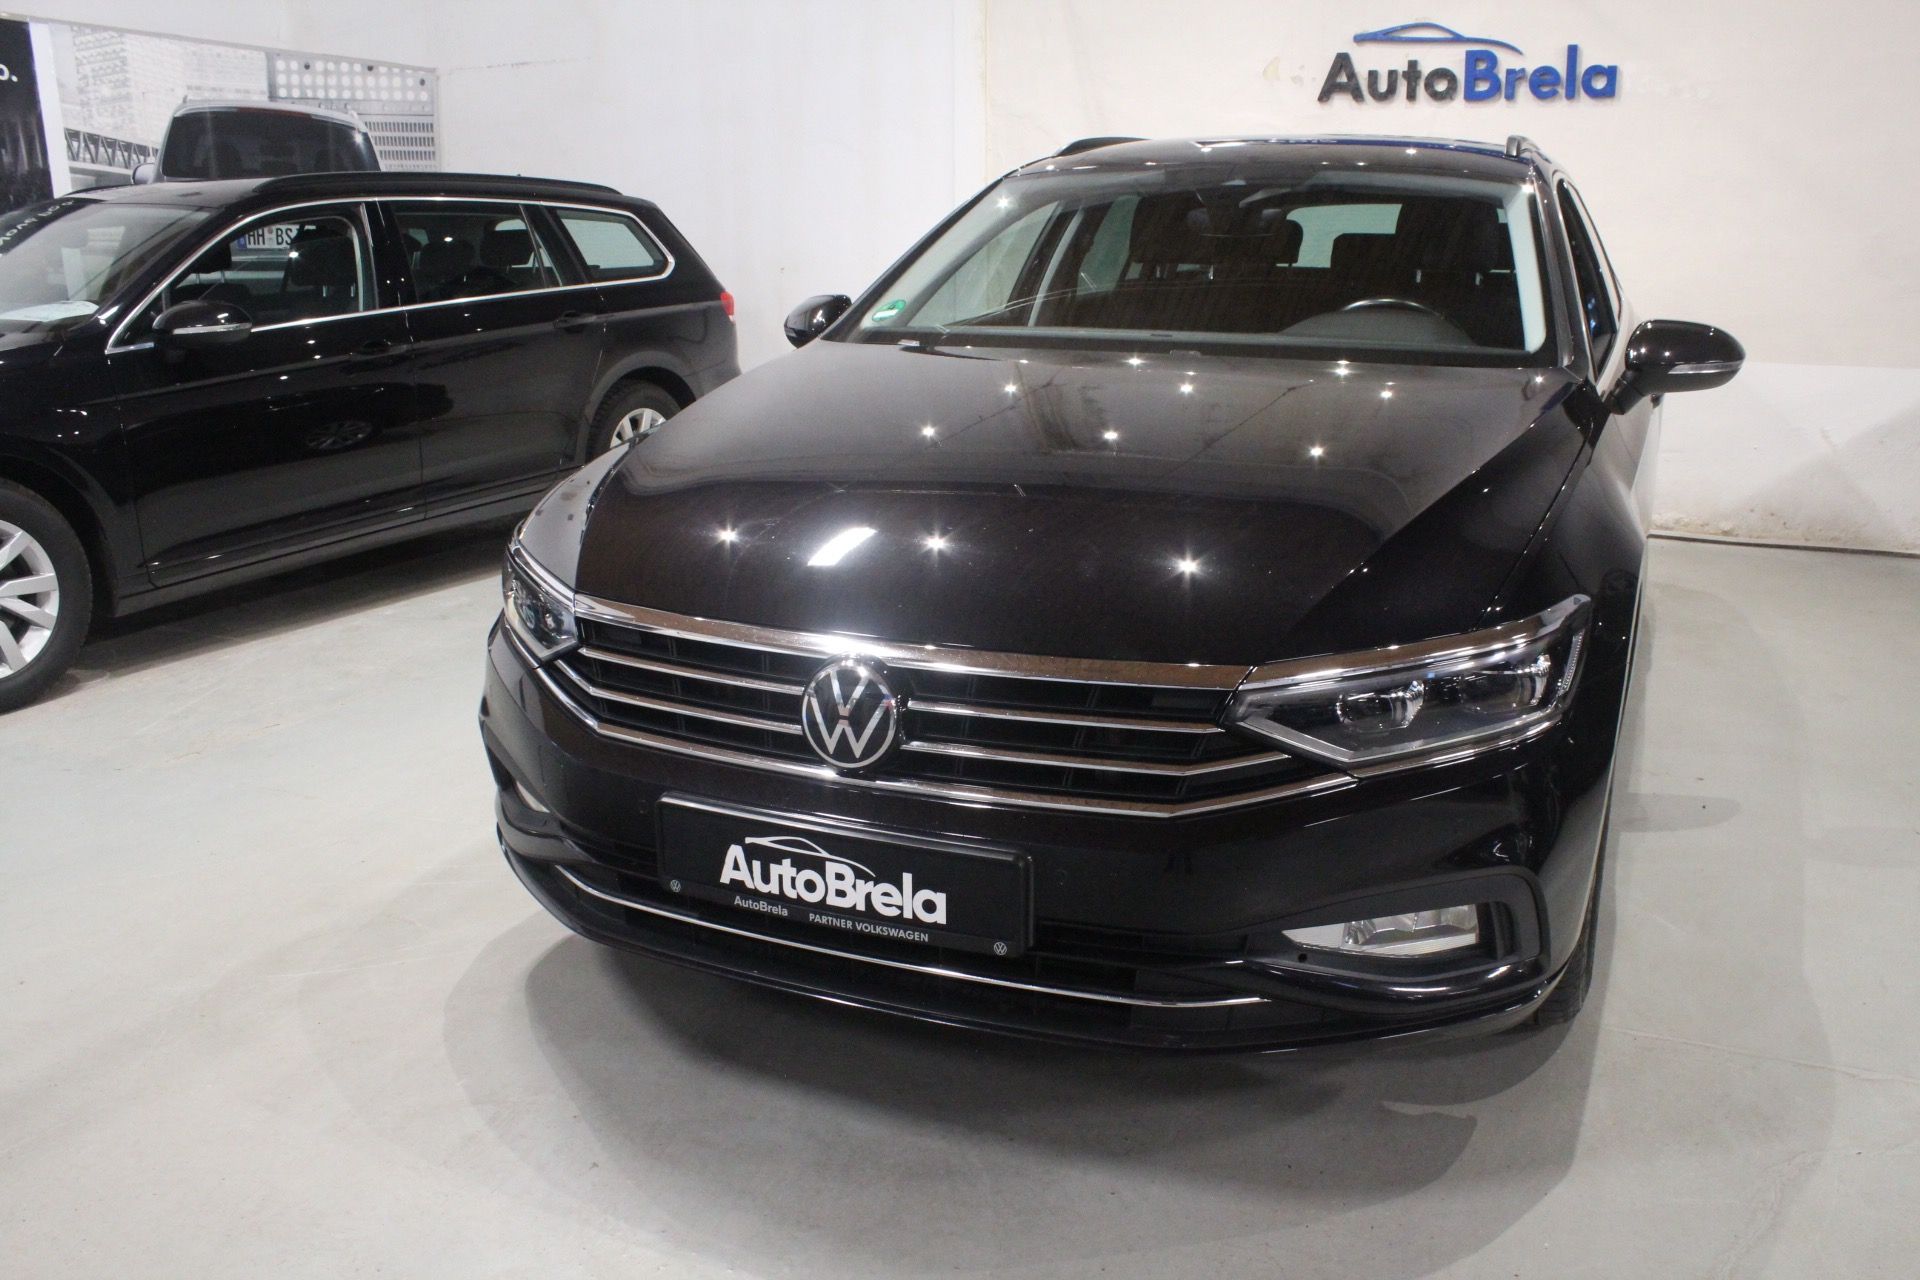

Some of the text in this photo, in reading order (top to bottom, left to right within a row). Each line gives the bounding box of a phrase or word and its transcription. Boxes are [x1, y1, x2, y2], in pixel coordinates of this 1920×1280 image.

[1317, 44, 1618, 102] AutoBrela
[720, 844, 947, 925] AutoBrela
[734, 896, 788, 917] AutoBrela
[809, 912, 929, 943] PARTNER VOLKSWAGEN
